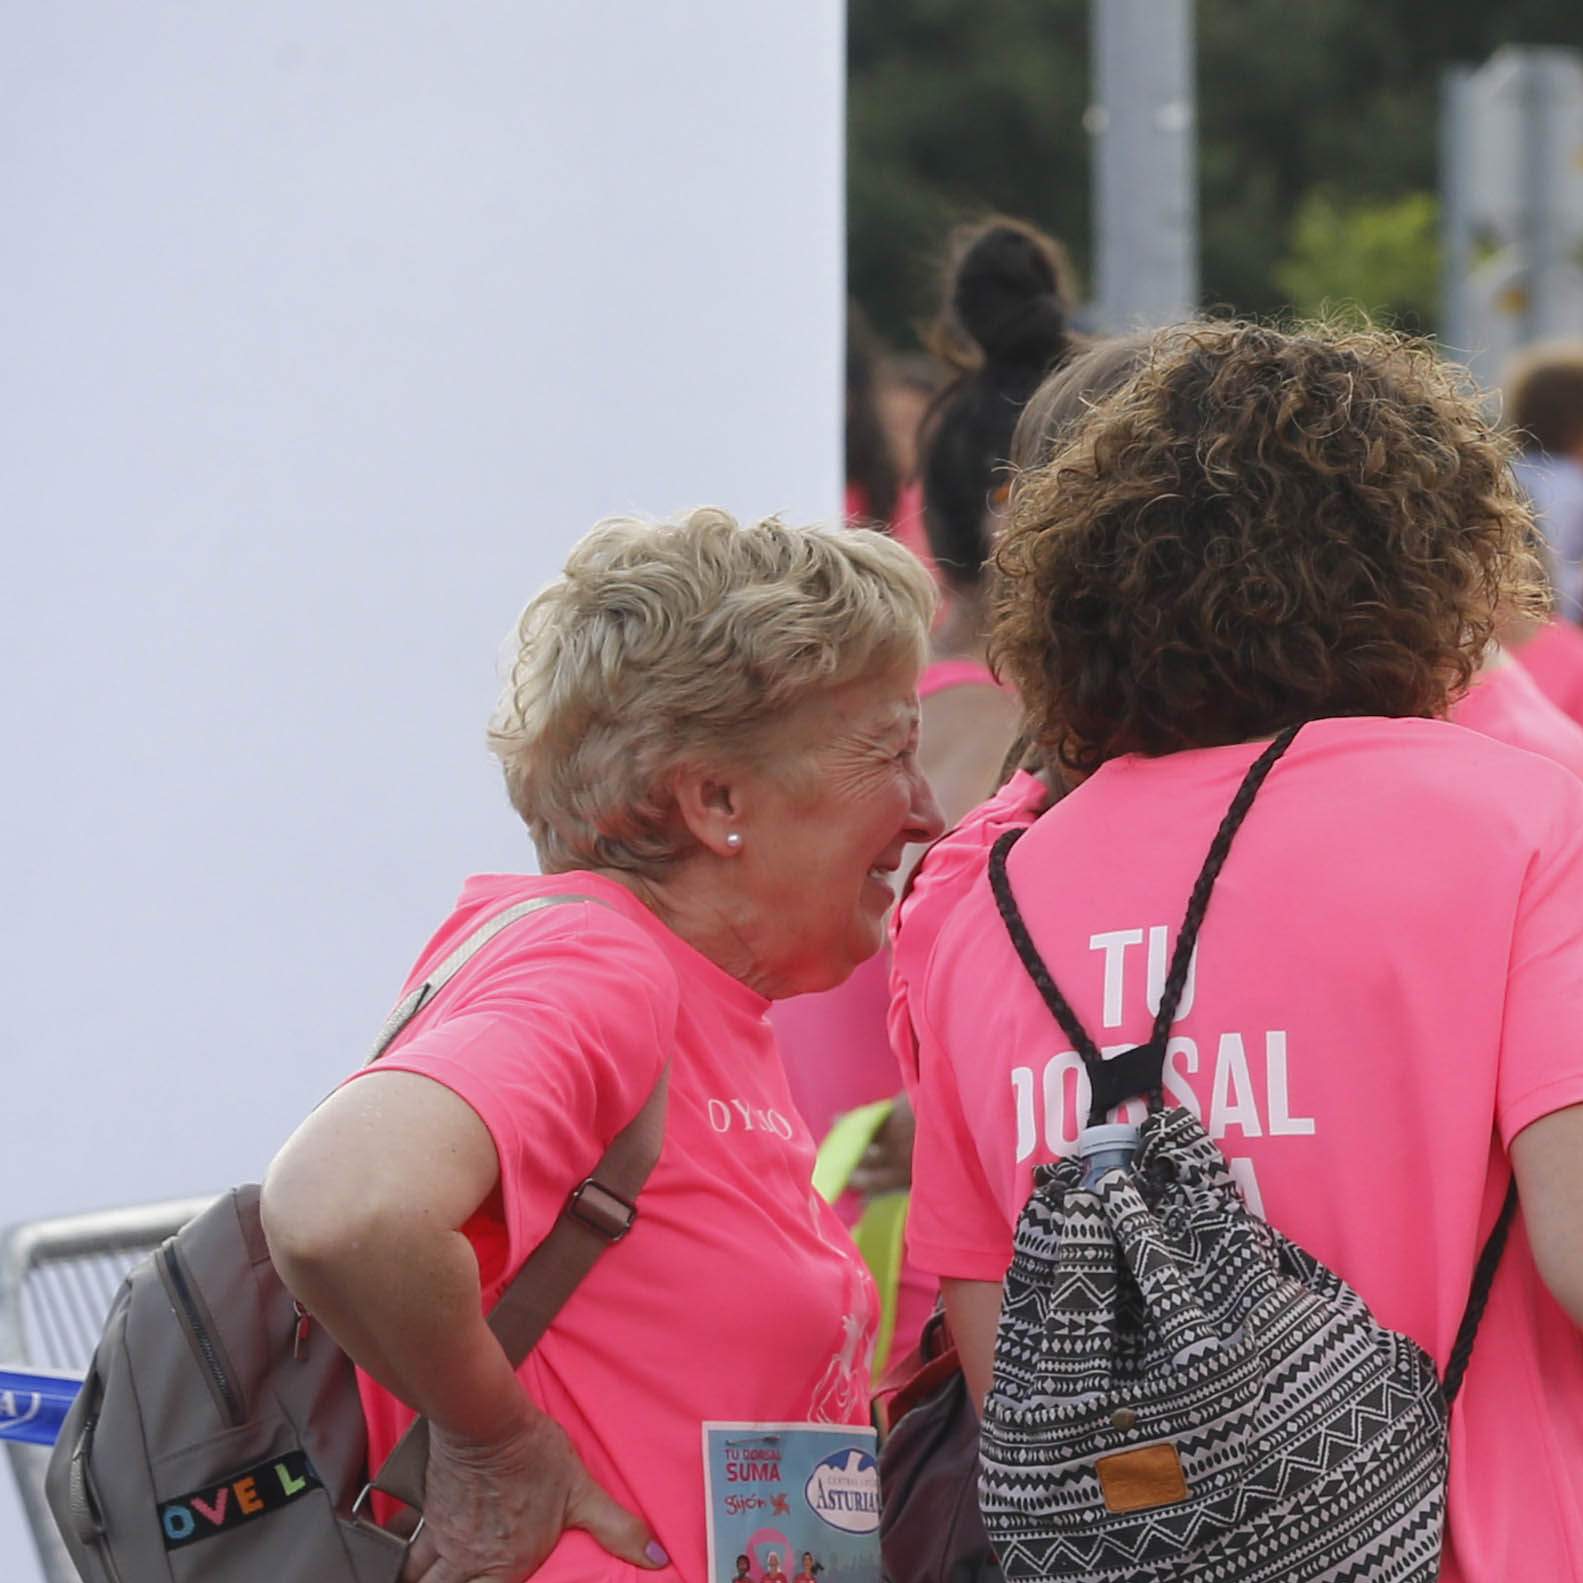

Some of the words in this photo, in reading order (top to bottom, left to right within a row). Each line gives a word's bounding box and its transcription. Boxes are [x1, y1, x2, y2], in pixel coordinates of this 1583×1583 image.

[1089, 925, 1199, 1028] TU
[1010, 1029, 1317, 1164] DOSAL
[274, 1461, 315, 1497] L
[726, 1463, 781, 1482] SUMA
